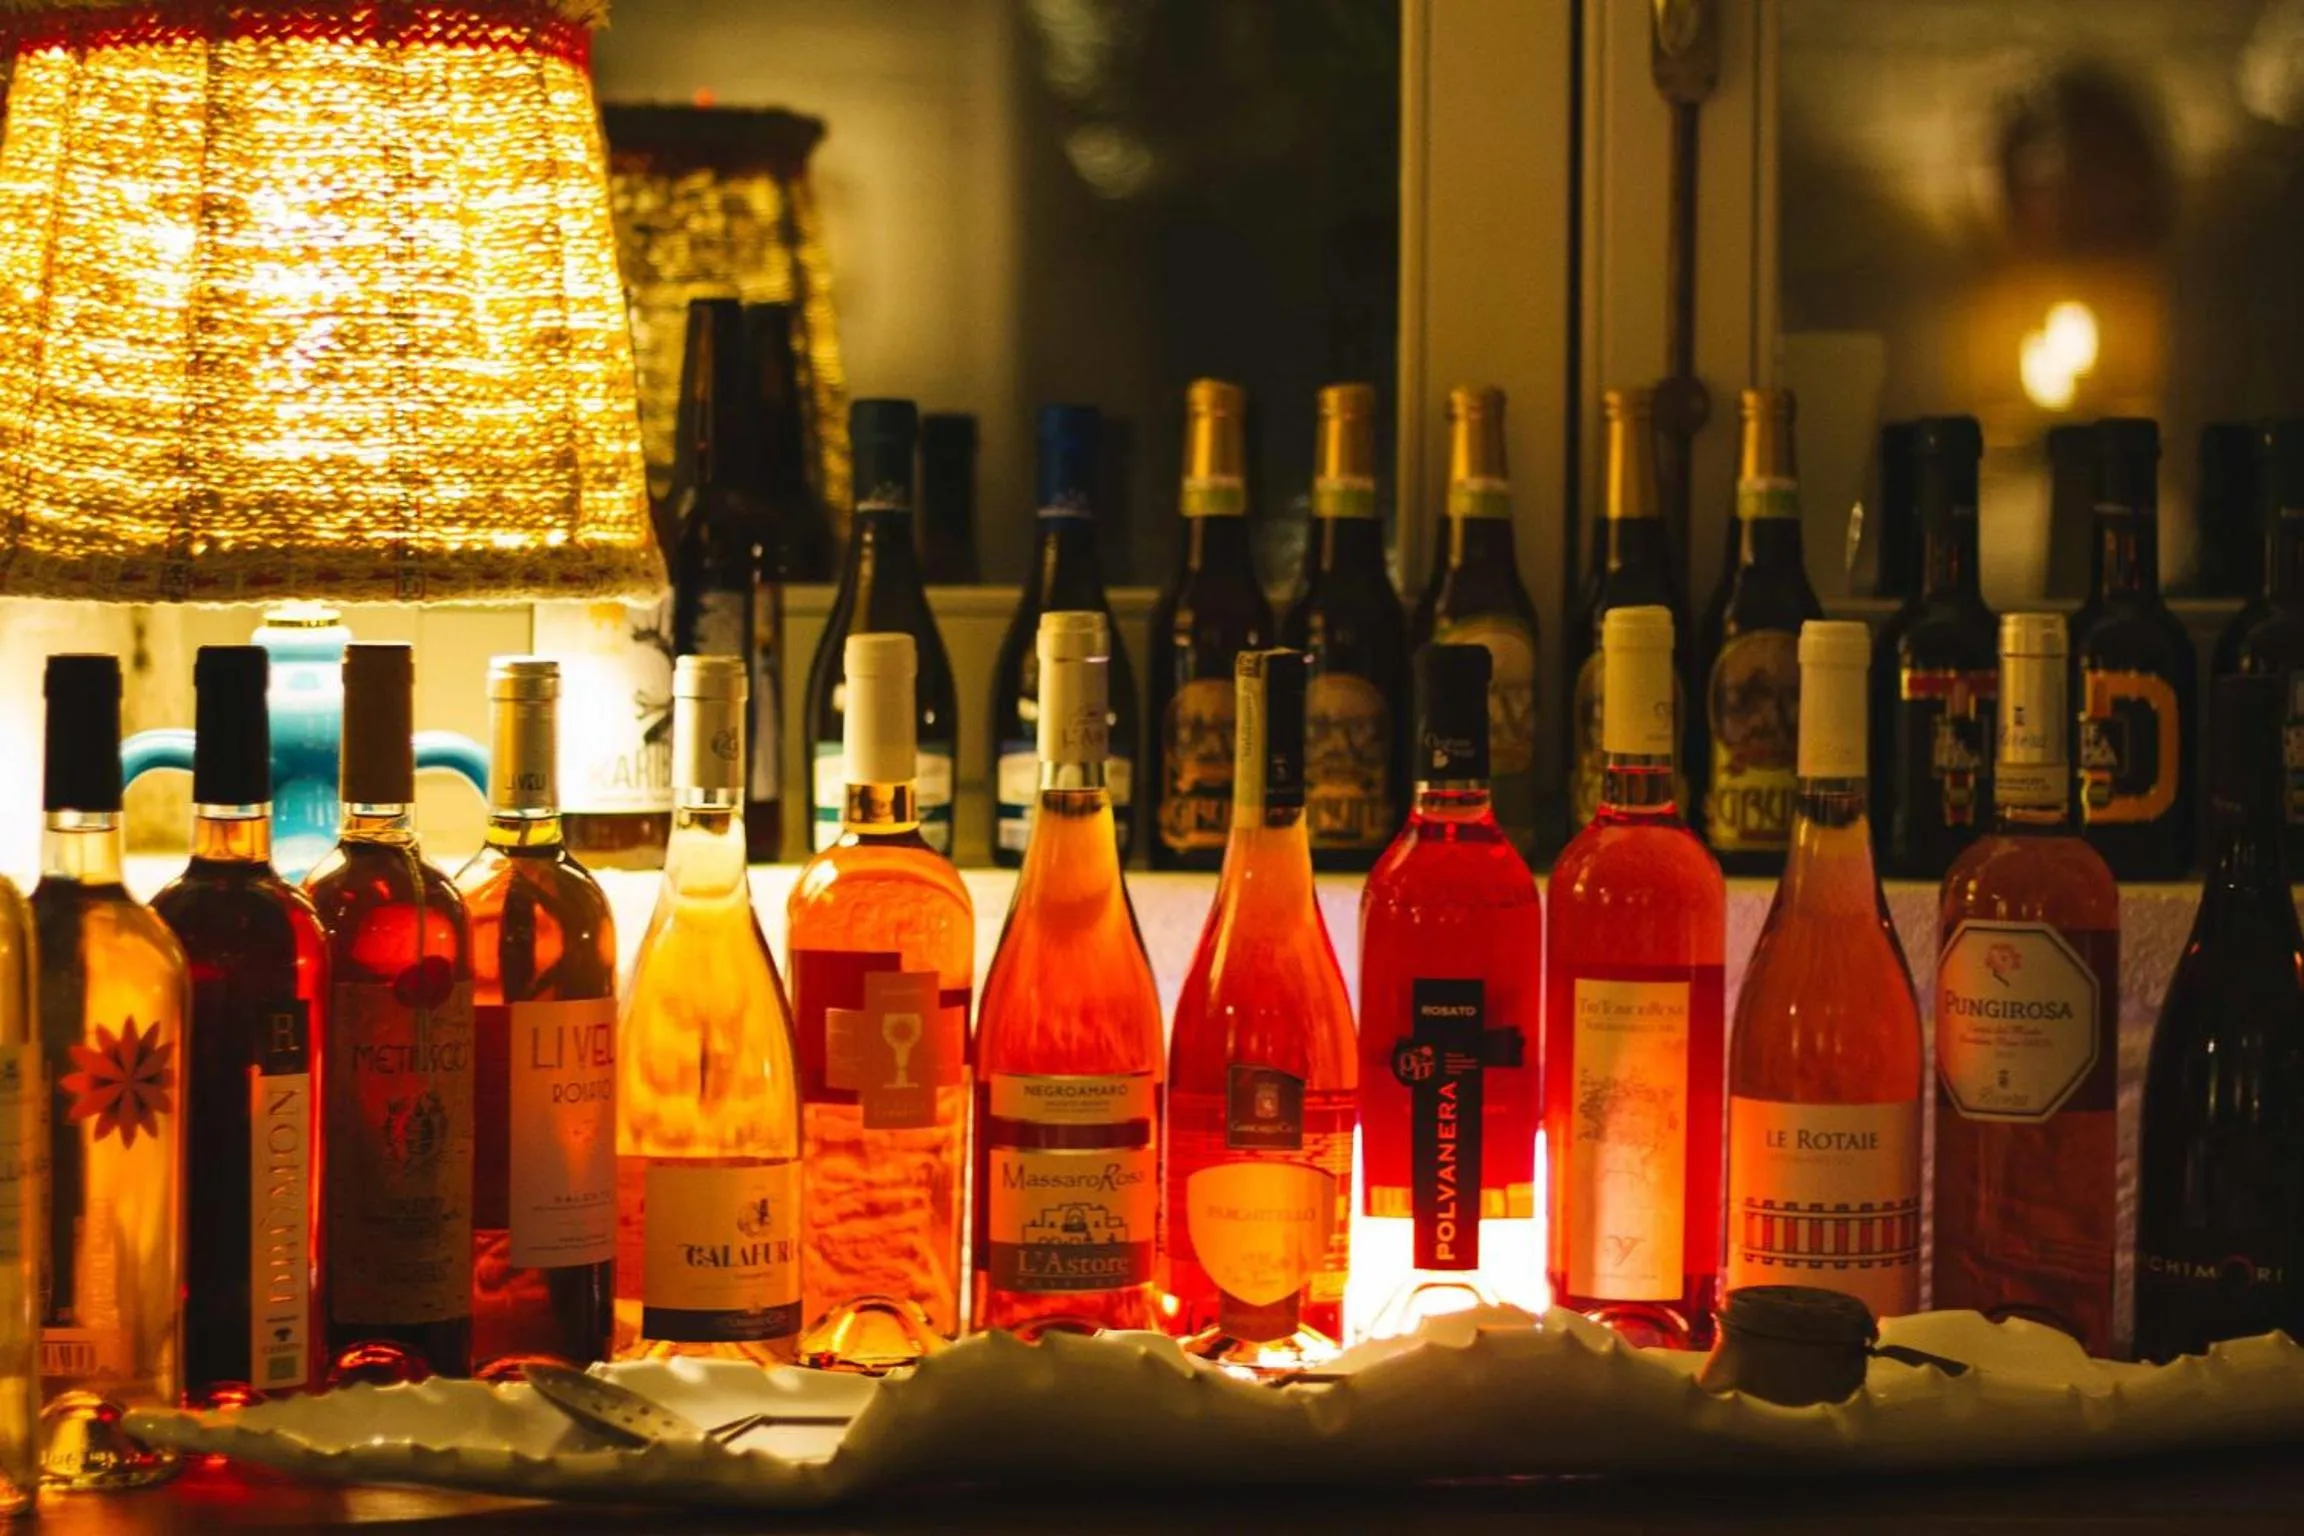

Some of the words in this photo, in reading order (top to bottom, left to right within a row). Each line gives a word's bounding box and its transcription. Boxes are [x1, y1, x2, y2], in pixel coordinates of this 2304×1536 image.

[2084, 669, 2180, 824] D
[1421, 1005, 1478, 1017] ROSATO
[1944, 990, 2073, 1021] PUNGIROSA
[1024, 1084, 1128, 1098] NEGROAMARO
[1767, 1130, 1787, 1148] LE
[1798, 1129, 1880, 1150] ROTAIE
[1437, 1080, 1458, 1261] POLVANERA
[1017, 1250, 1131, 1275] L'Astore
